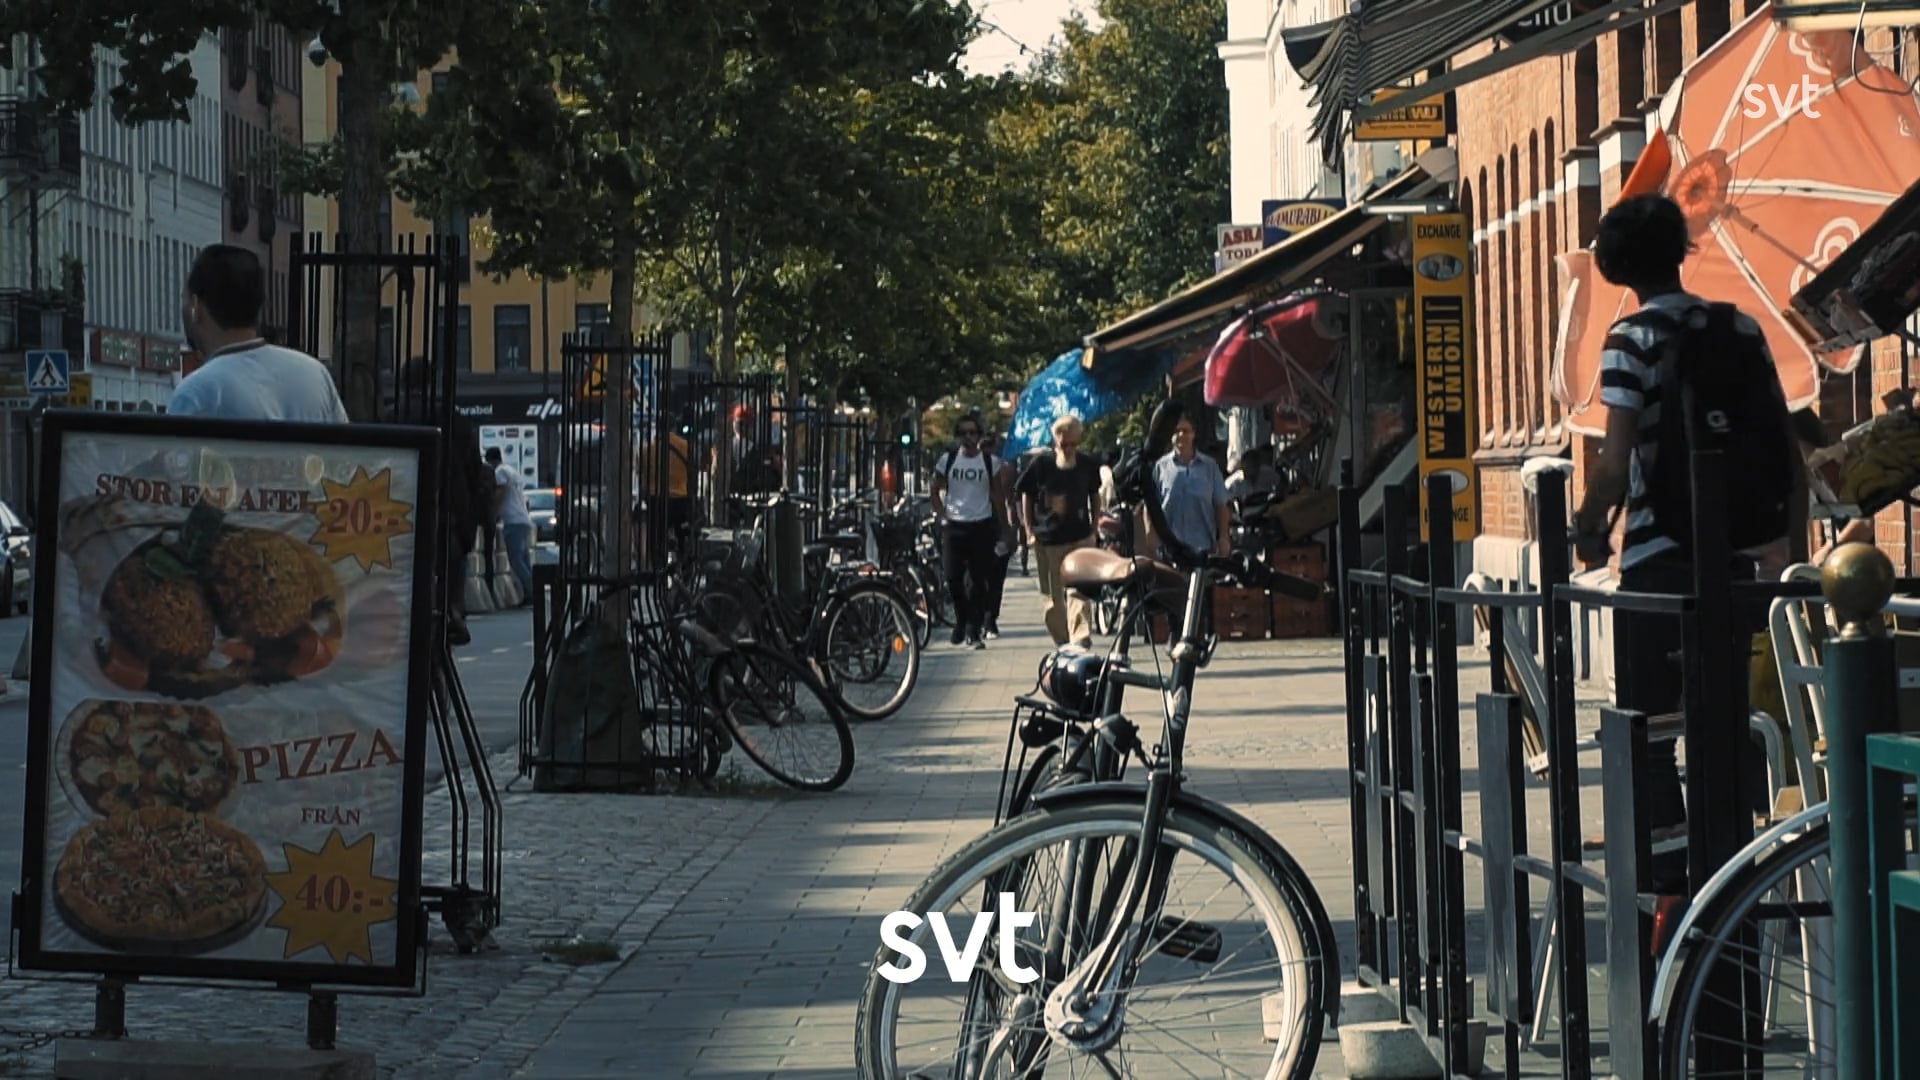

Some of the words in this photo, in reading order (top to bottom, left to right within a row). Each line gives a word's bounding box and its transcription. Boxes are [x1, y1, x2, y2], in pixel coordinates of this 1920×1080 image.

[1417, 223, 1462, 239] EXCHANGE
[1443, 324, 1463, 413] UNION
[1425, 324, 1446, 453] WESTERN
[95, 473, 172, 506] STOR
[951, 467, 985, 482] RIOT
[238, 728, 403, 785] PIZZA
[302, 805, 361, 825] FRÅN
